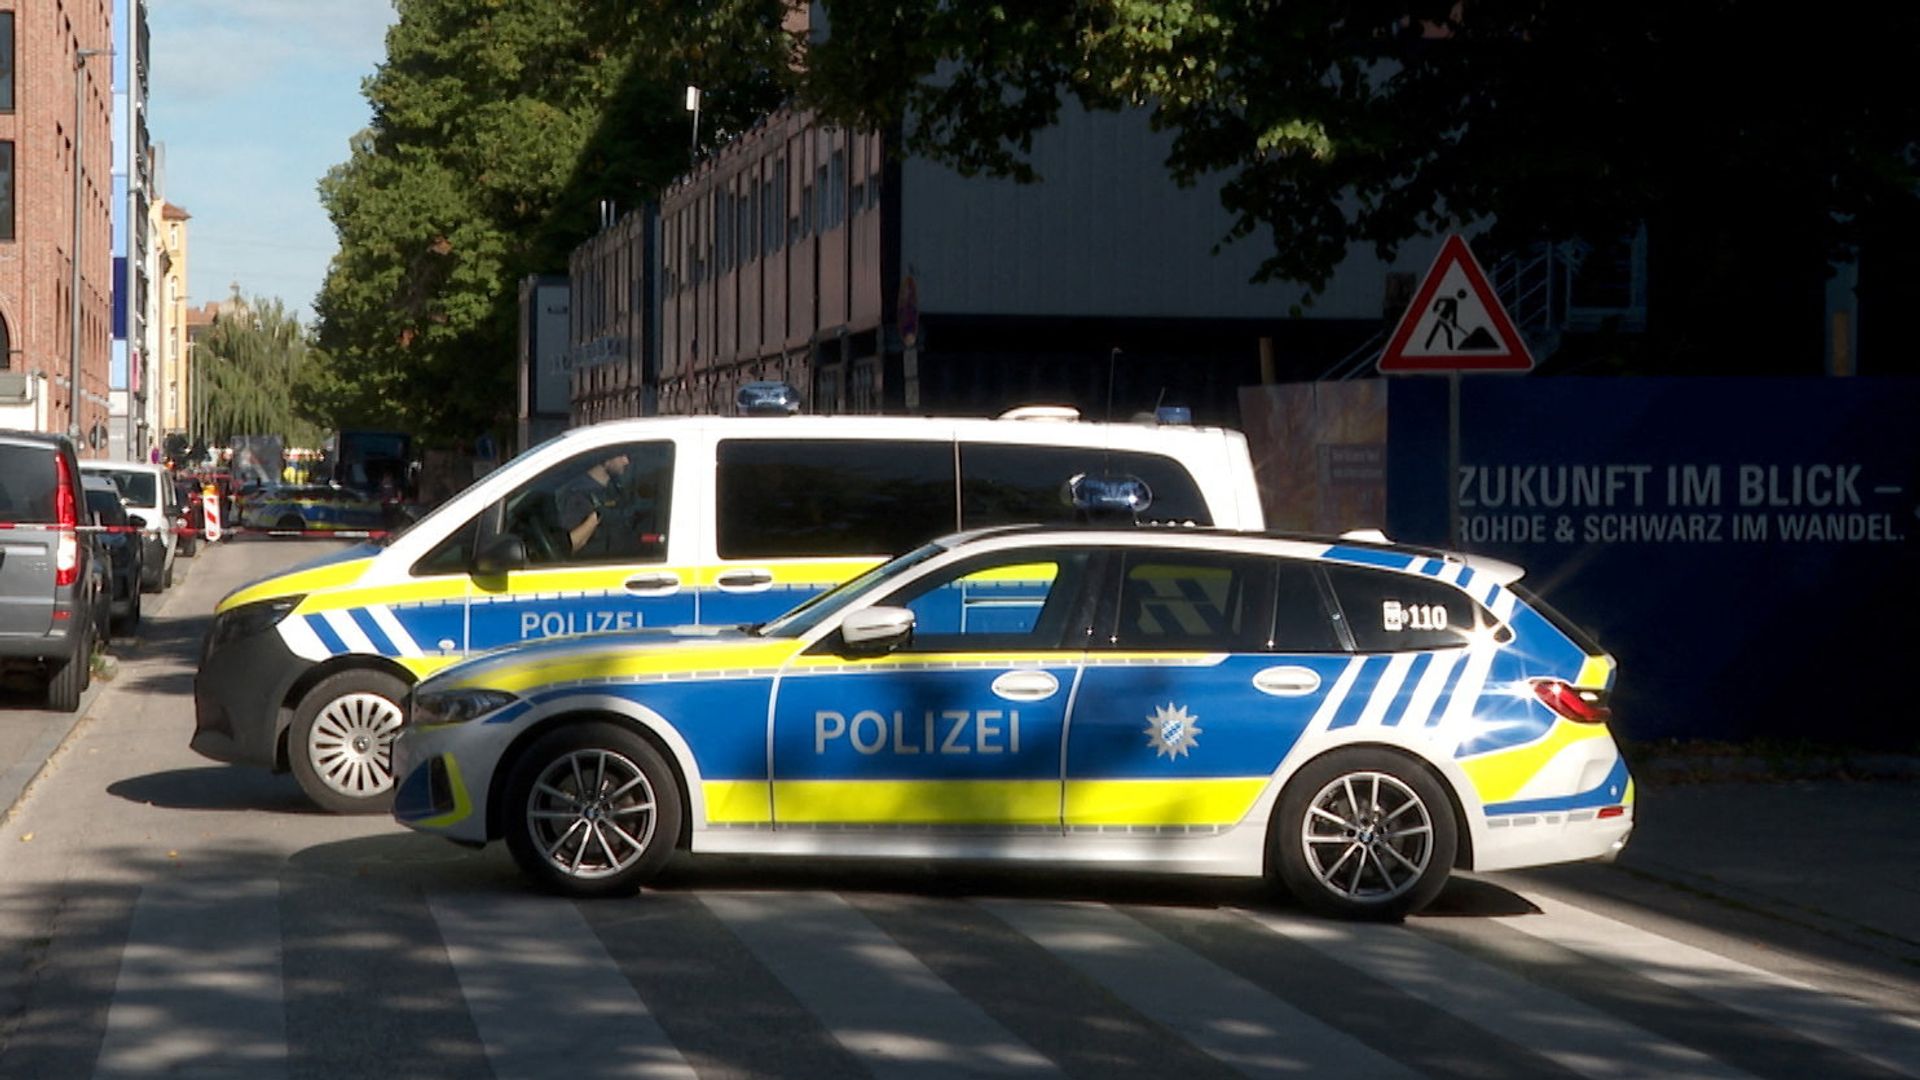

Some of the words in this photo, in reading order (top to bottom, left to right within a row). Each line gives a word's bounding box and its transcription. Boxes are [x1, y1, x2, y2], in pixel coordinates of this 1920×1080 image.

[1459, 464, 1653, 507] ZUKUNFT
[1668, 464, 1722, 507] IM
[1739, 464, 1863, 507] BLICK
[1554, 514, 1576, 543] &
[1583, 514, 1723, 543] SCHWARZ
[1732, 514, 1768, 543] IM
[1777, 514, 1905, 543] WANDEL.
[1408, 604, 1448, 631] 110
[815, 709, 1020, 755] POLIZEI
